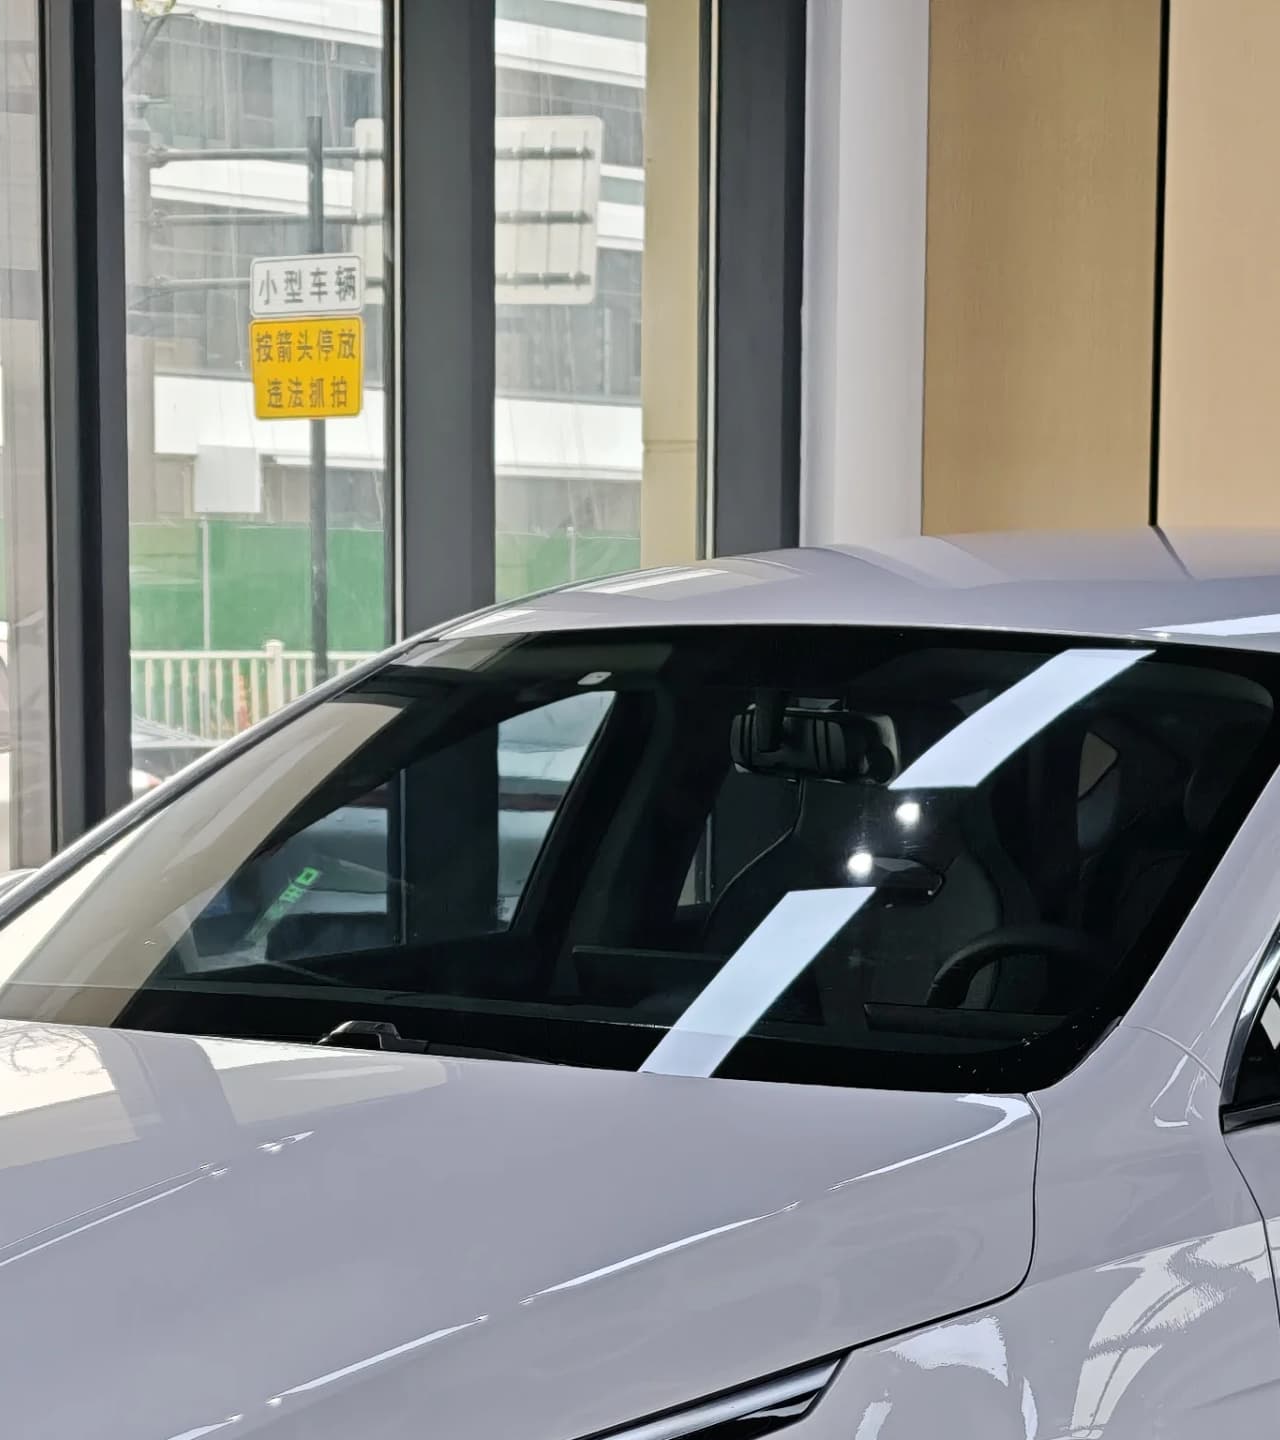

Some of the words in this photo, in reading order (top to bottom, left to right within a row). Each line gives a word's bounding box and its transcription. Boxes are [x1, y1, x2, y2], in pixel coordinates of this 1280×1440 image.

[258, 265, 357, 306] 小型车辆
[255, 328, 357, 364] 按箭头停放
[266, 375, 348, 409] 违法抓拍
